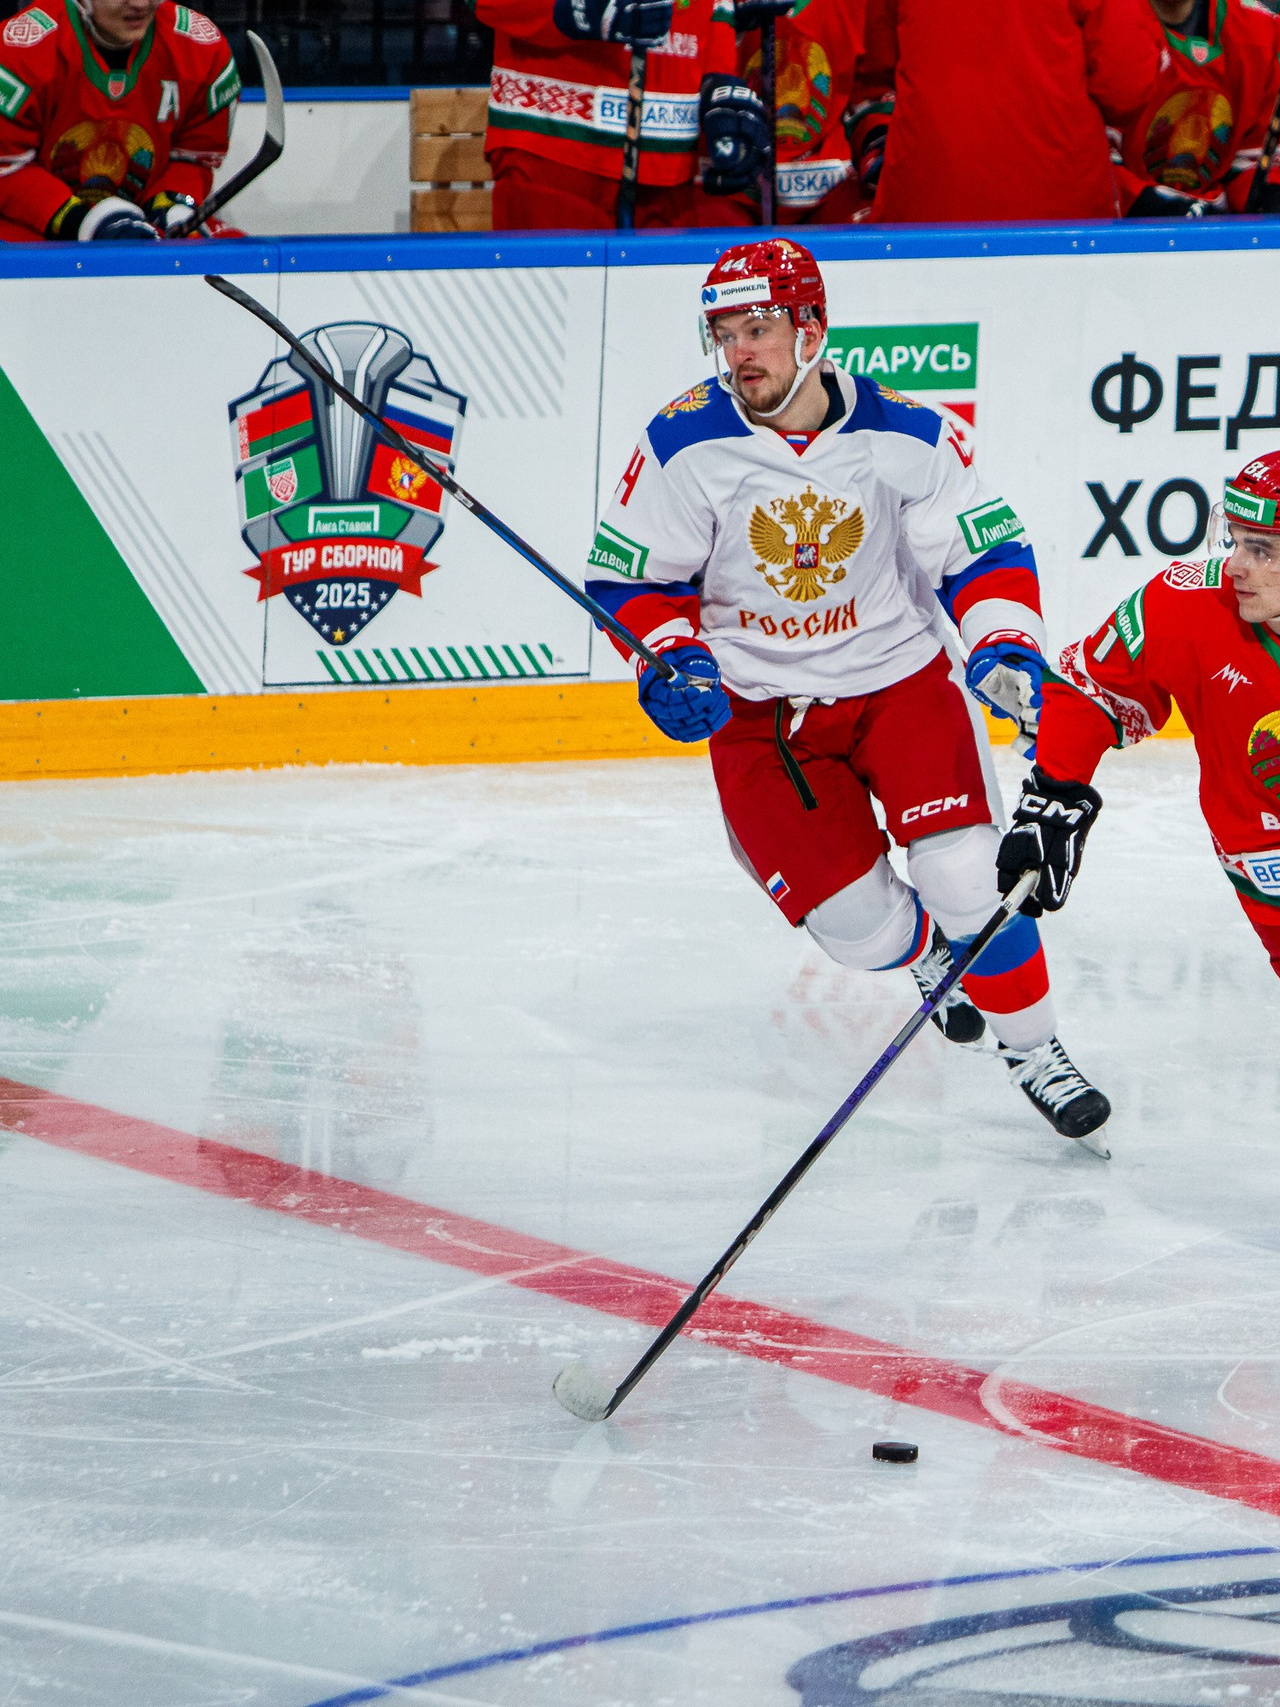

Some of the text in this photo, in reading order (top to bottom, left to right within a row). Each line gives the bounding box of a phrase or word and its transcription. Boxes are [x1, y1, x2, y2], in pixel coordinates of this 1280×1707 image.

[157, 80, 180, 123] A
[720, 257, 747, 273] 44
[720, 282, 768, 297] НОРНИКЕЛЬ
[826, 344, 972, 374] ЕЛАРУСЬ
[615, 445, 646, 507] 4
[1244, 461, 1270, 481] 81
[1234, 500, 1257, 520] СТАВОК
[982, 523, 1008, 545] ЛИГА
[281, 544, 404, 575] ТУР СБОРНОЙ
[314, 582, 371, 610] 2025
[738, 595, 859, 641] РОССИЯ
[1091, 623, 1119, 664] 1
[901, 794, 969, 825] CCM
